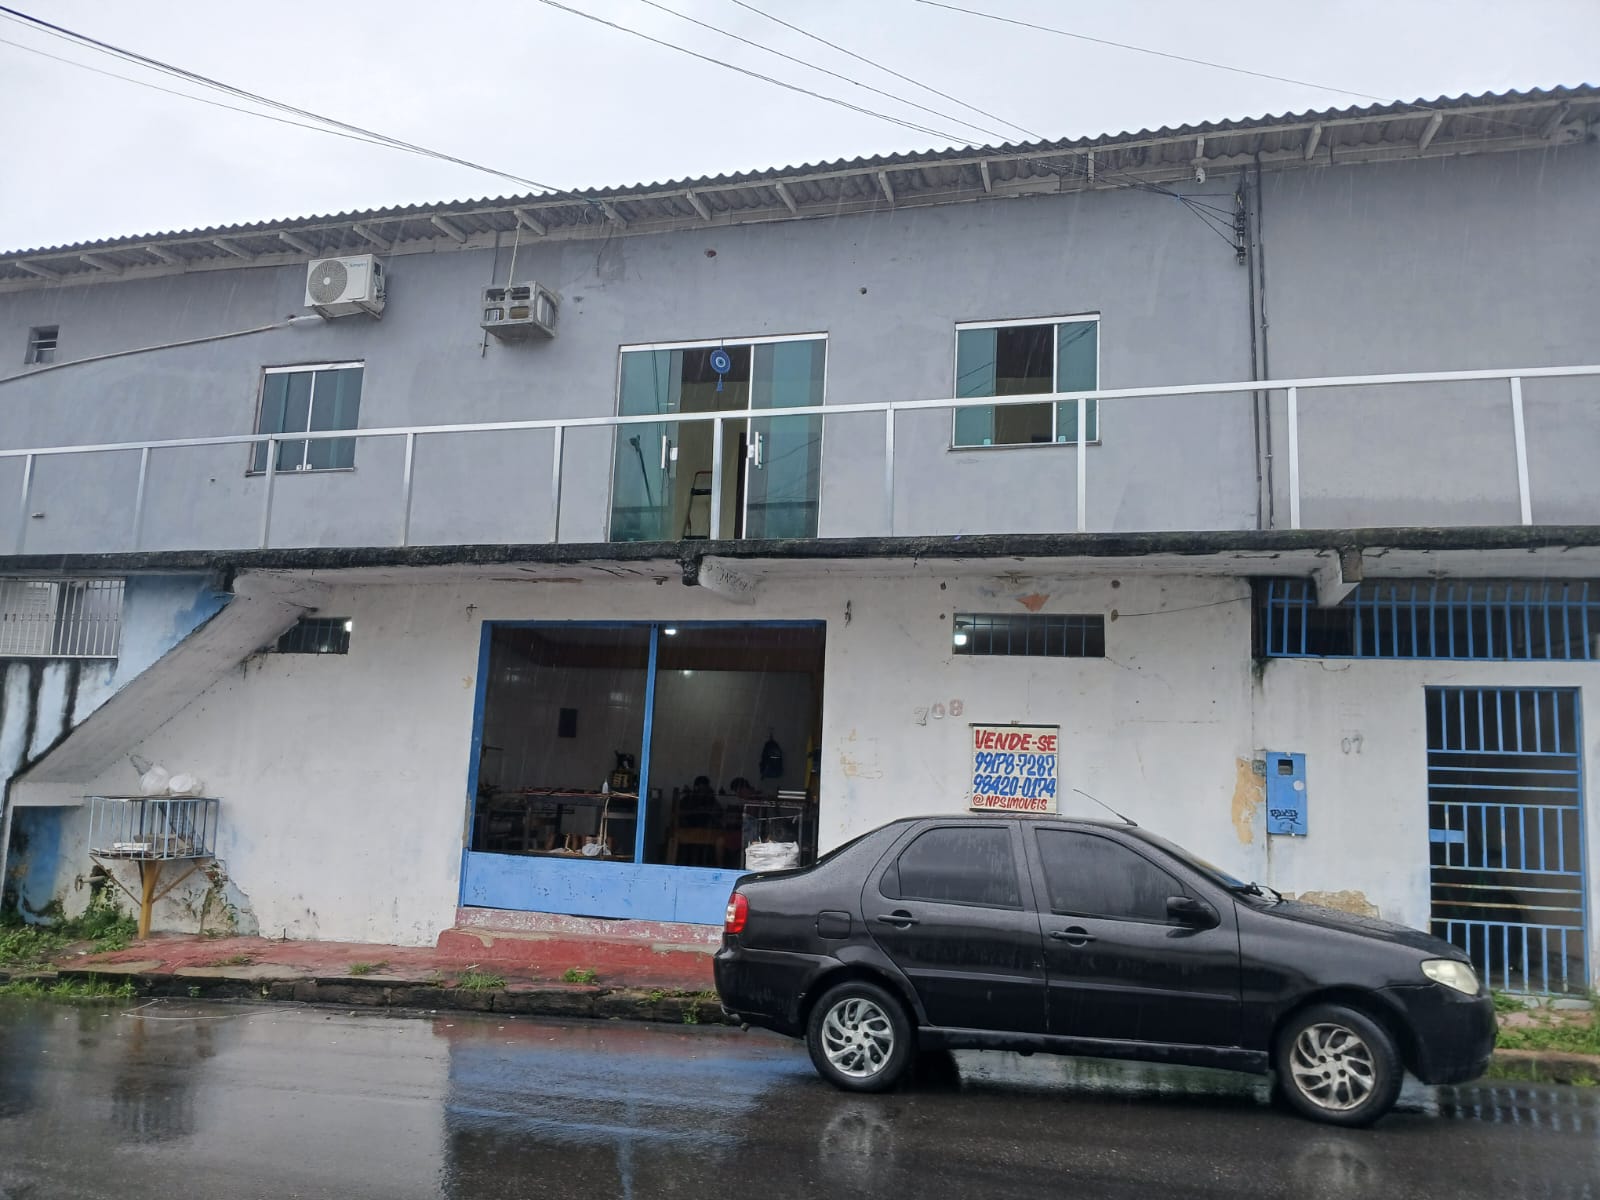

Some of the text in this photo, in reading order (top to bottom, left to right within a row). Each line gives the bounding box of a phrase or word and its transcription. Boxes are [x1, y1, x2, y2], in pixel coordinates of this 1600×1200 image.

[975, 729, 1057, 752] VENDE-SE
[974, 751, 1056, 777] 99178-7287
[973, 773, 1057, 799] 98420-0174
